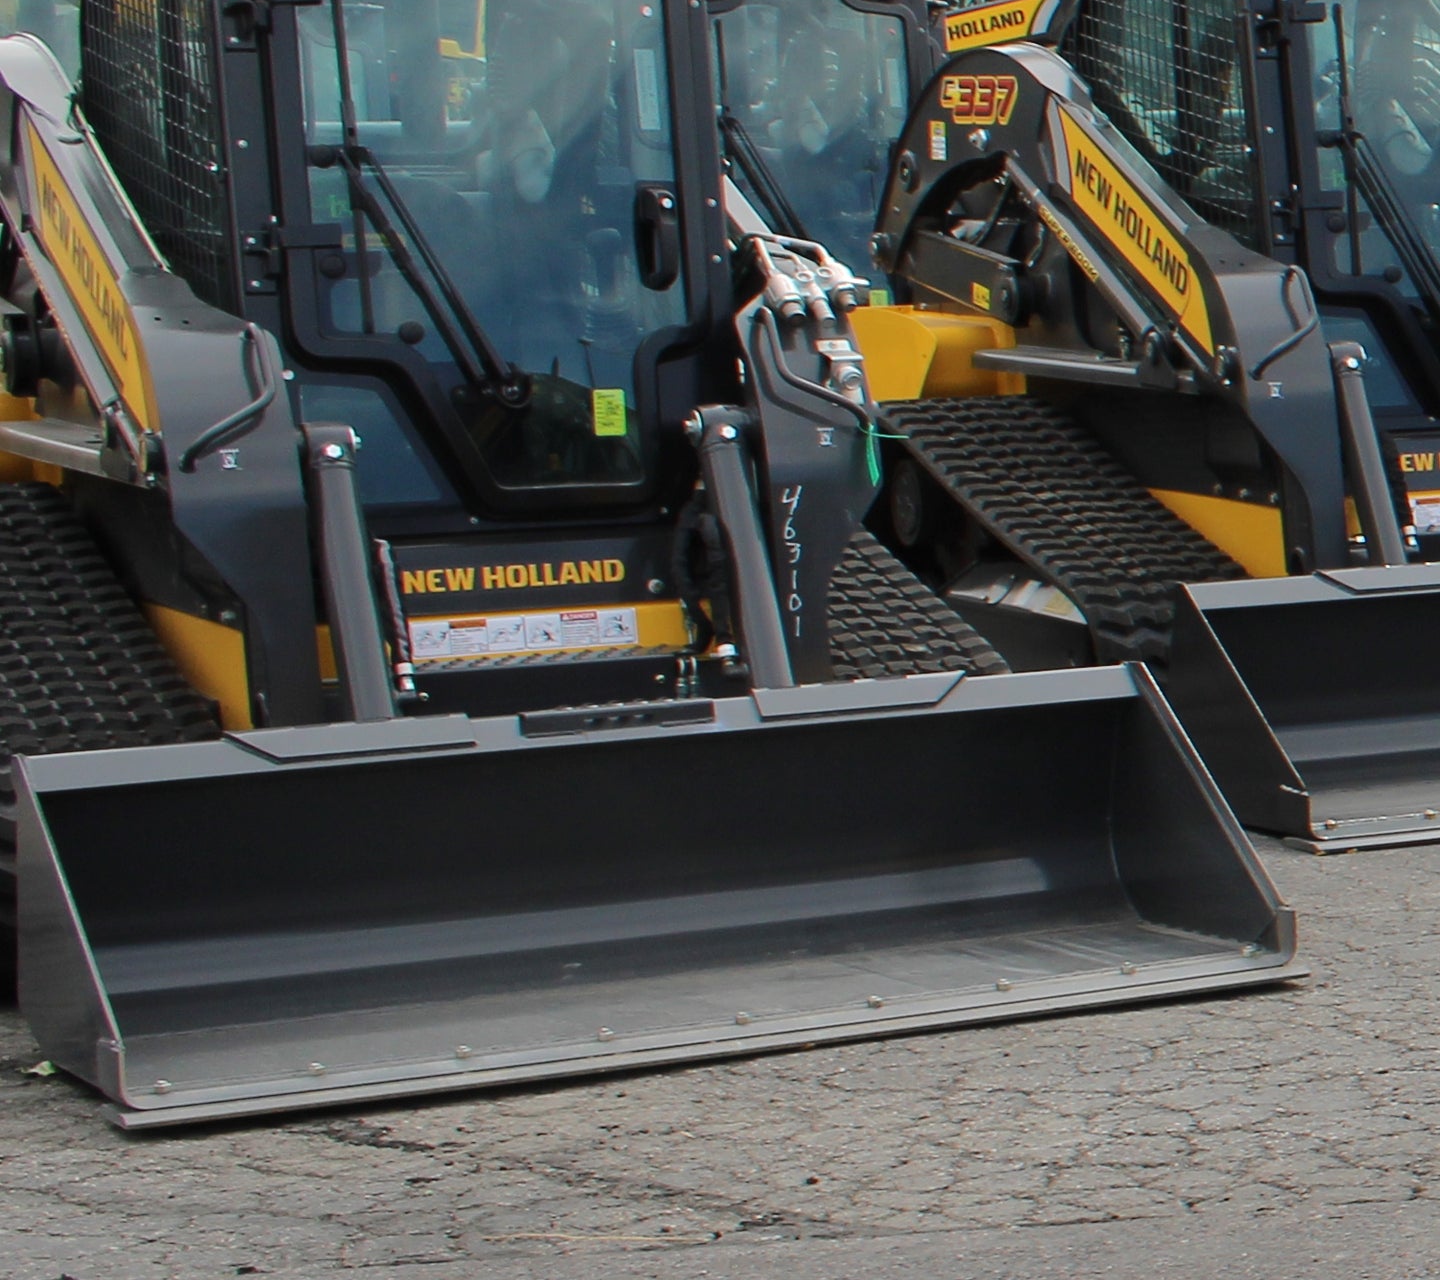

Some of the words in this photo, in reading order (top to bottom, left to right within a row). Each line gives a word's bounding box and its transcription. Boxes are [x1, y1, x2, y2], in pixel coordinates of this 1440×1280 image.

[949, 9, 1026, 41] HOLLAND
[42, 174, 71, 252] NEW
[1074, 149, 1114, 210] NEW
[1113, 191, 1188, 296] HOLLAND
[1399, 452, 1435, 472] EW
[402, 568, 475, 595] NEW
[482, 558, 626, 590] HOLLAND
[782, 484, 802, 638] 463101
